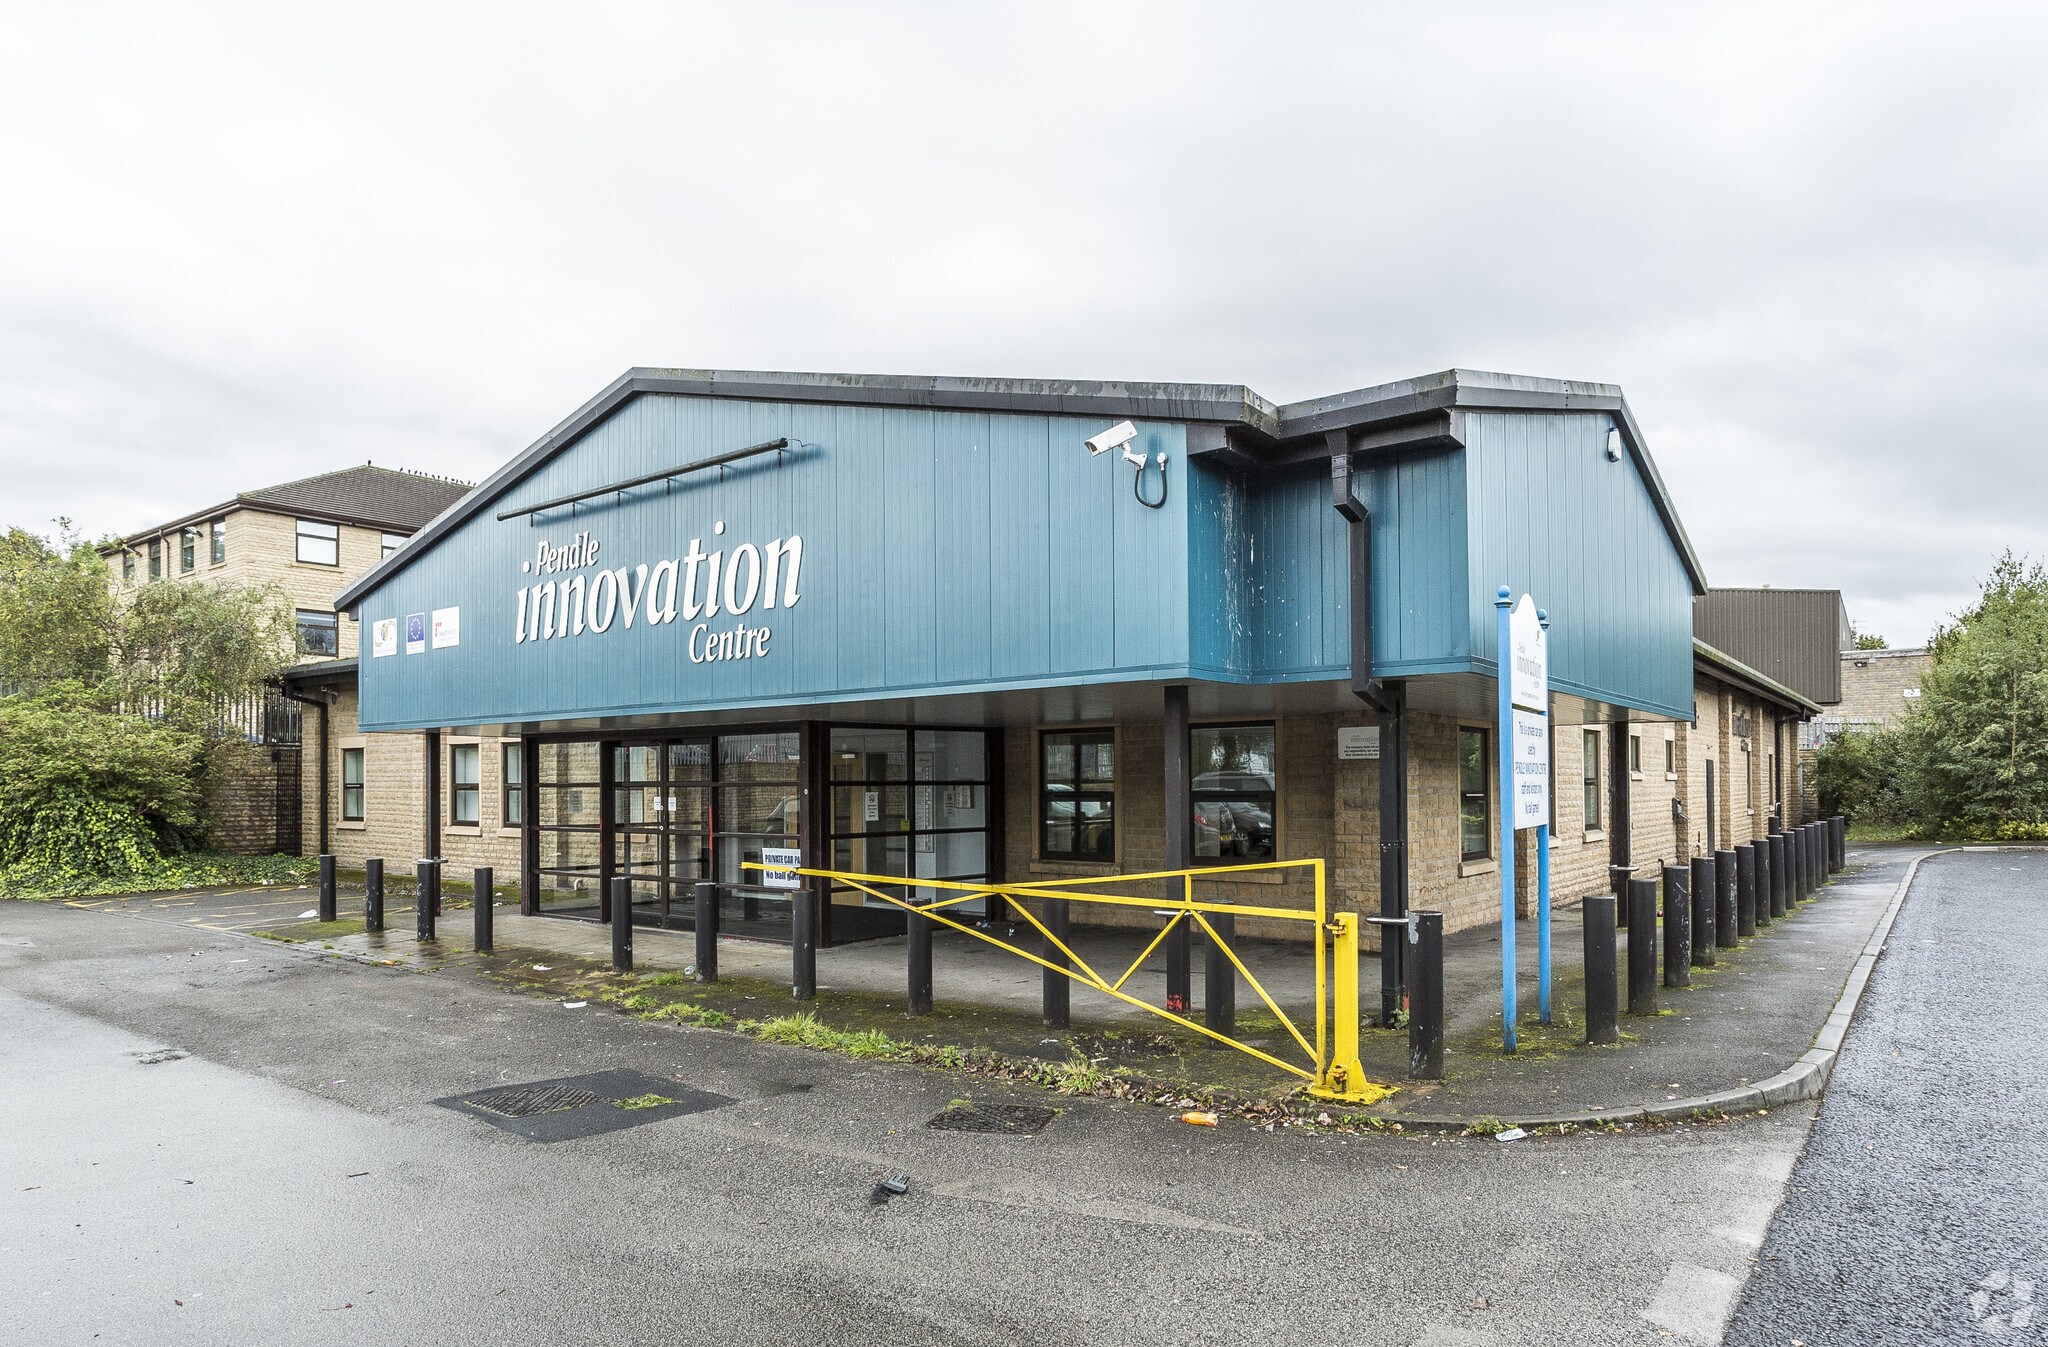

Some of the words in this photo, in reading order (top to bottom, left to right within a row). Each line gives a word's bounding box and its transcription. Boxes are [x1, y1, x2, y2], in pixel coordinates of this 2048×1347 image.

[536, 531, 600, 576] Pendle
[516, 520, 803, 644] innovation
[688, 623, 771, 663] Centre
[765, 854, 783, 863] PRIVATE
[784, 855, 793, 864] CAR
[766, 871, 773, 879] No
[775, 871, 786, 880] ball
